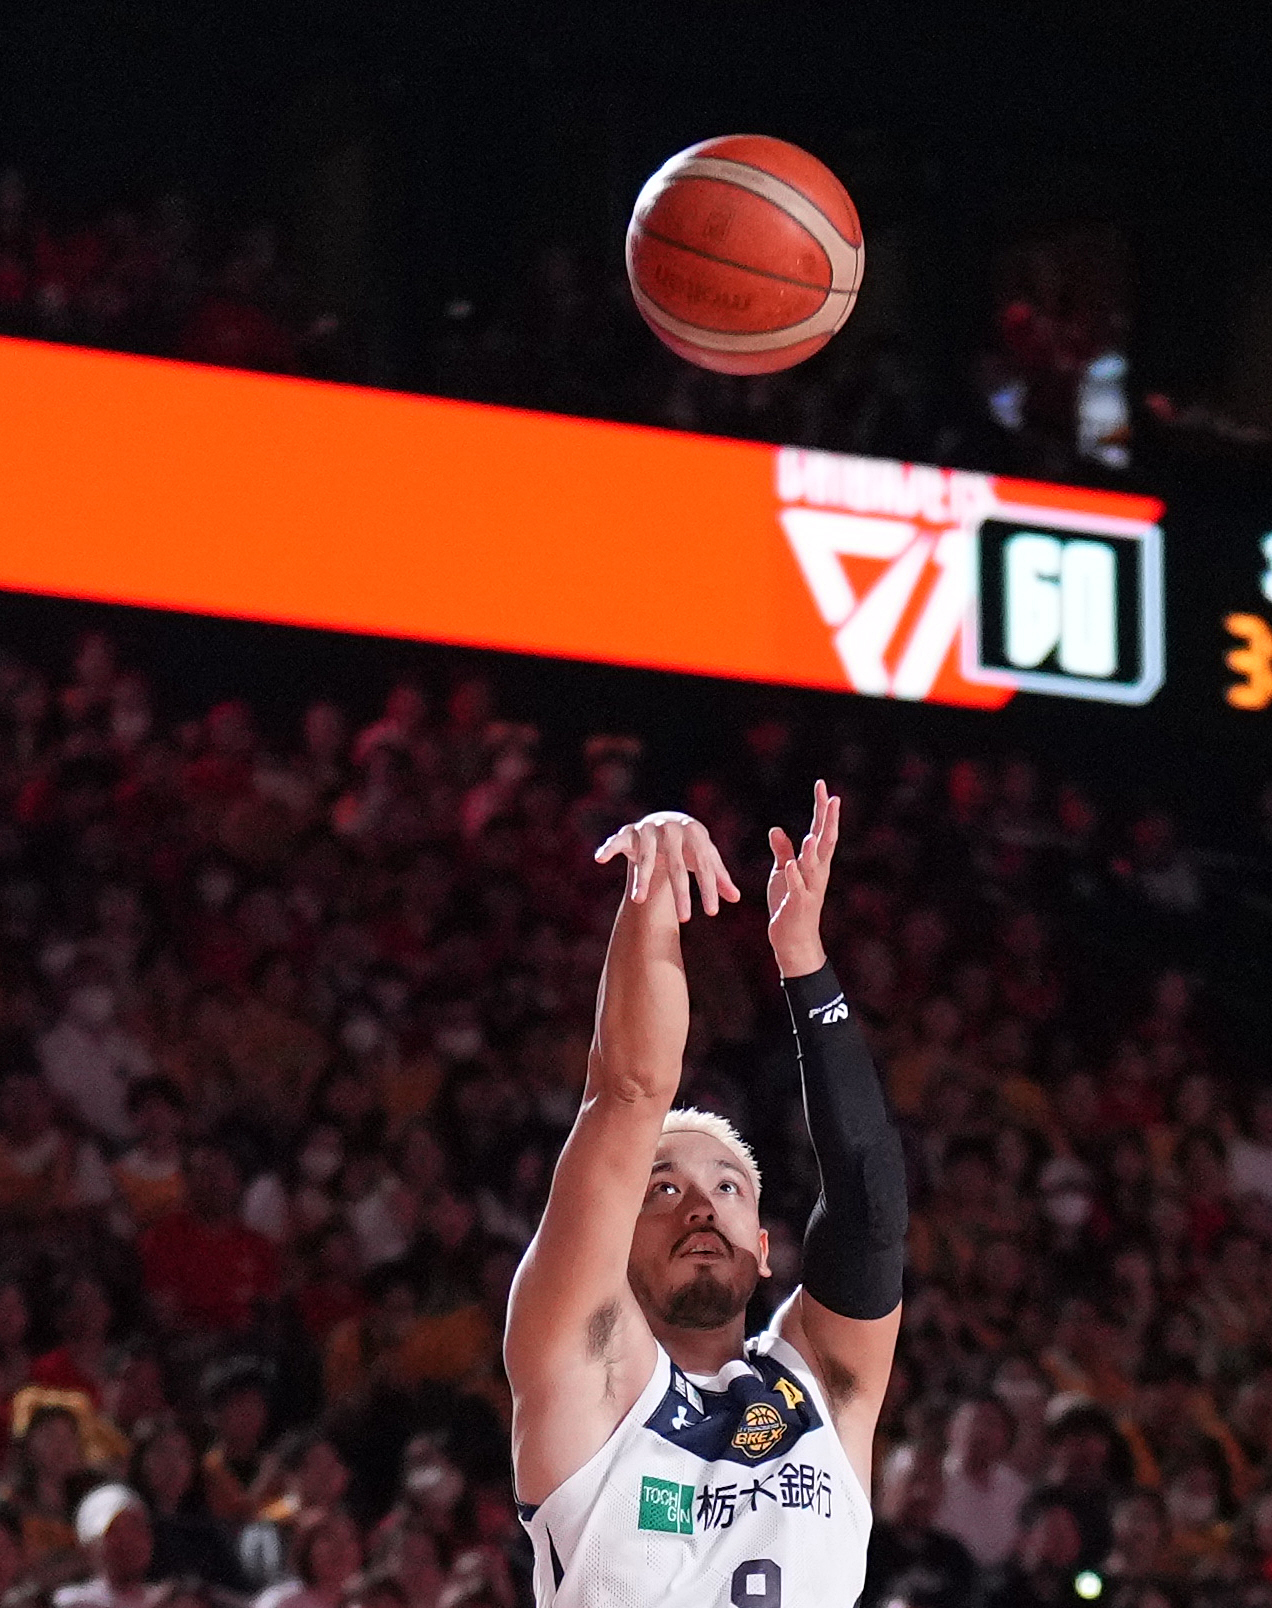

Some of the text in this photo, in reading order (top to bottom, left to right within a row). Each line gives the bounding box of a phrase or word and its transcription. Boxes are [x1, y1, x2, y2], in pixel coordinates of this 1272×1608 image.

[734, 1427, 784, 1446] BREX
[696, 1462, 832, 1532] 栃木銀行
